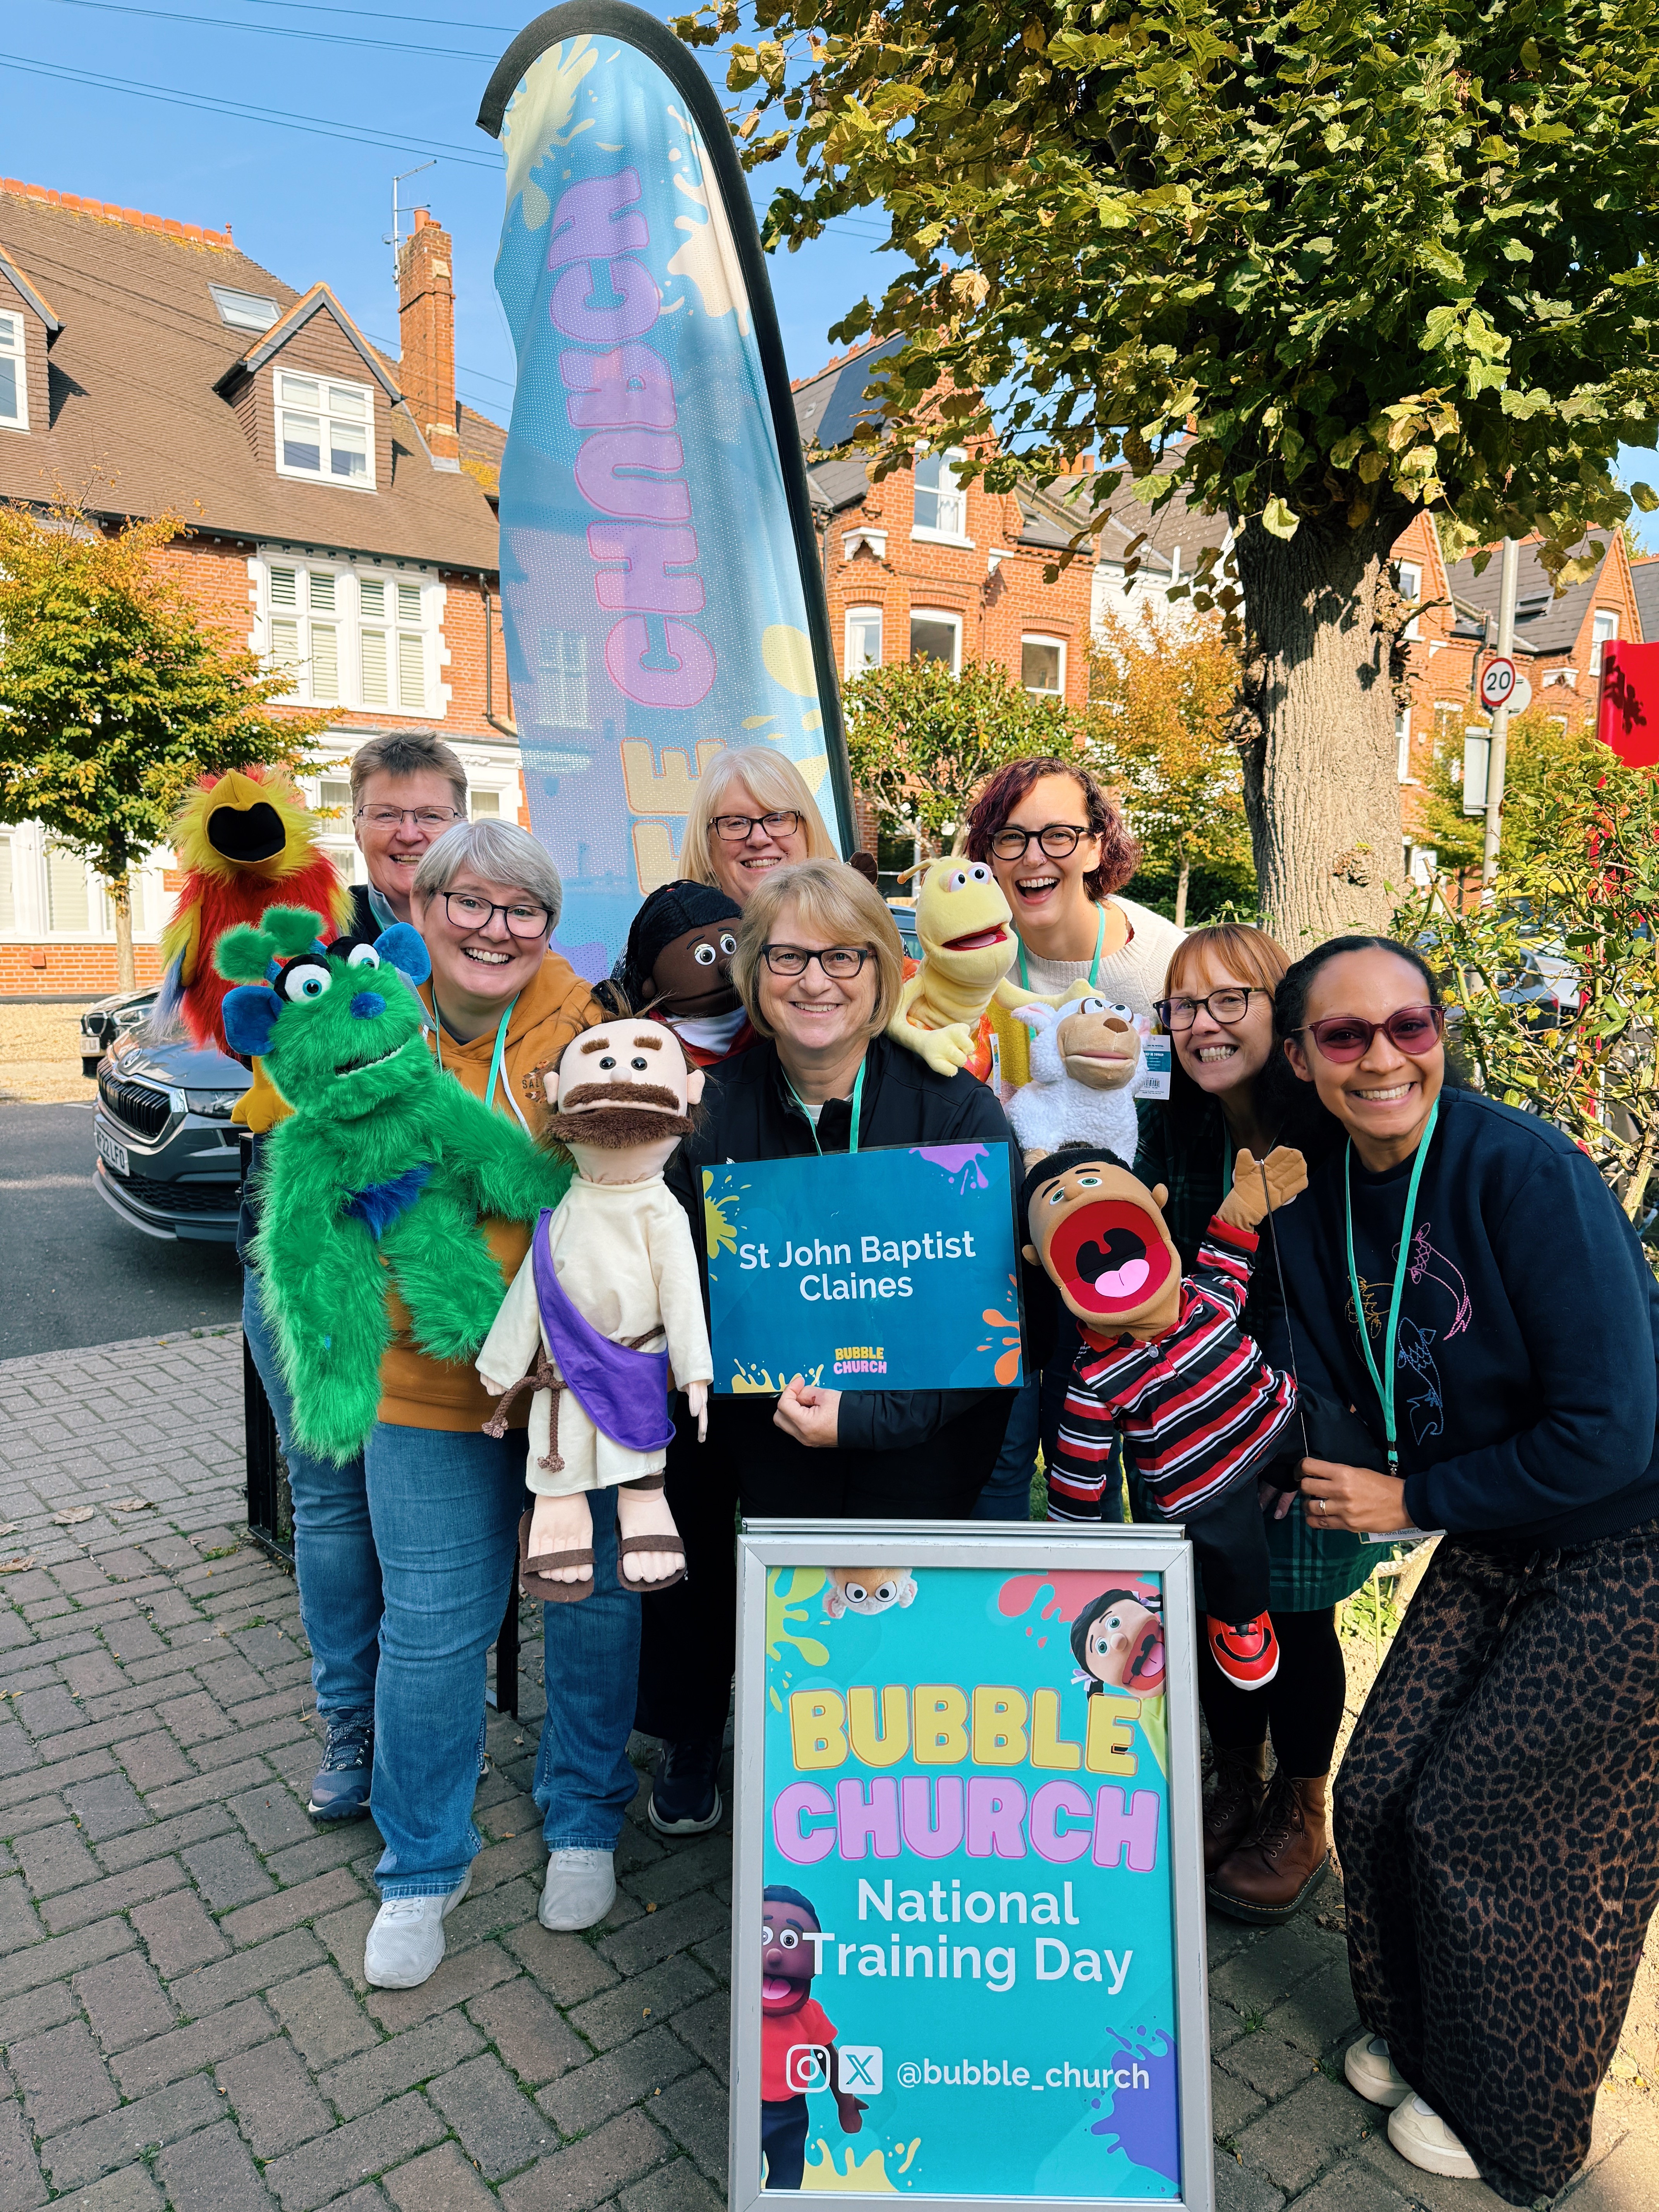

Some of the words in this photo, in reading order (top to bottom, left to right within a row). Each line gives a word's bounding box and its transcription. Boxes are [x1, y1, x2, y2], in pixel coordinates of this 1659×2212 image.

[1486, 671, 1510, 691] 20
[739, 1243, 771, 1270] St
[778, 1238, 851, 1268] John
[861, 1231, 976, 1268] Baptist
[800, 1272, 913, 1301] Claines
[833, 1360, 887, 1374] CHURCH
[835, 1346, 884, 1360] BUBBLE
[790, 1684, 1142, 1777] BUBBLE
[773, 1775, 1160, 1873] CHURCH
[858, 1879, 1080, 1925] National
[802, 1932, 1016, 1992] Training
[1036, 1937, 1133, 1995] Day
[897, 2058, 1150, 2090] @bubble_church
